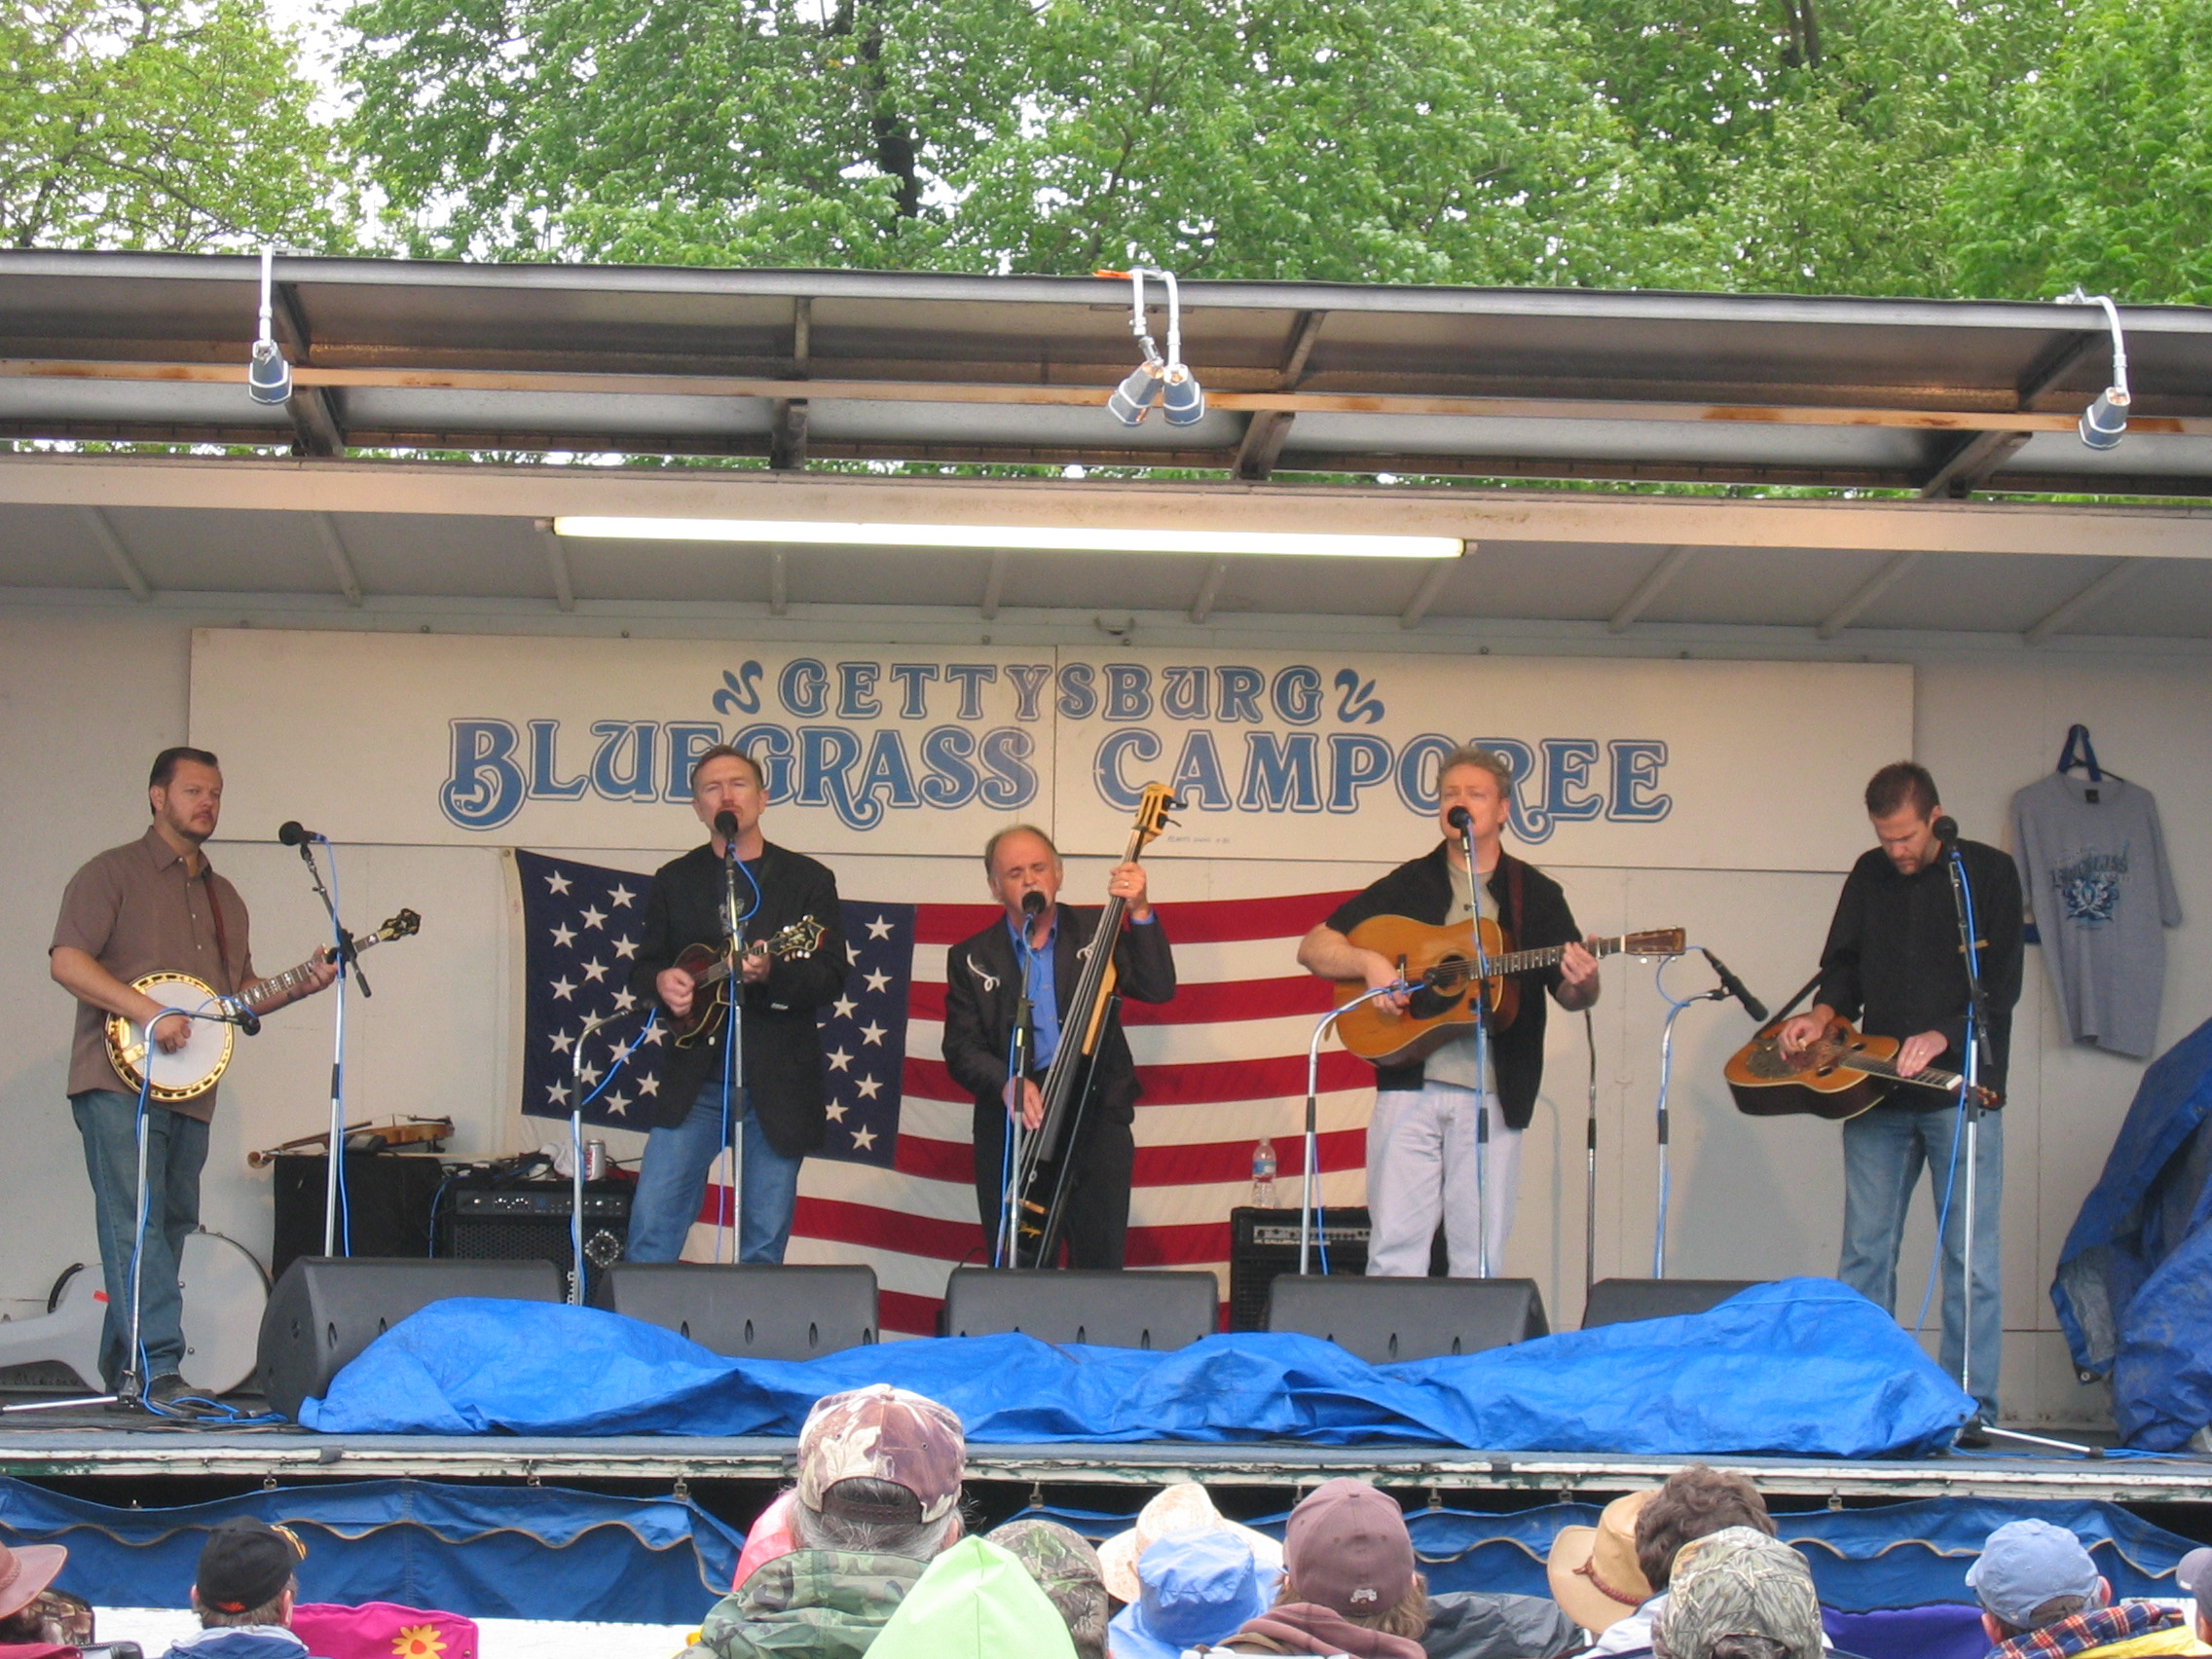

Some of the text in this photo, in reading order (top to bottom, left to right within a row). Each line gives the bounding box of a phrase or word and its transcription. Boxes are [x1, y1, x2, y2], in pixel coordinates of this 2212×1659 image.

[778, 658, 1323, 724] GETTYSBURG
[439, 718, 1673, 844] BLUEGRASS CAMPOREE
